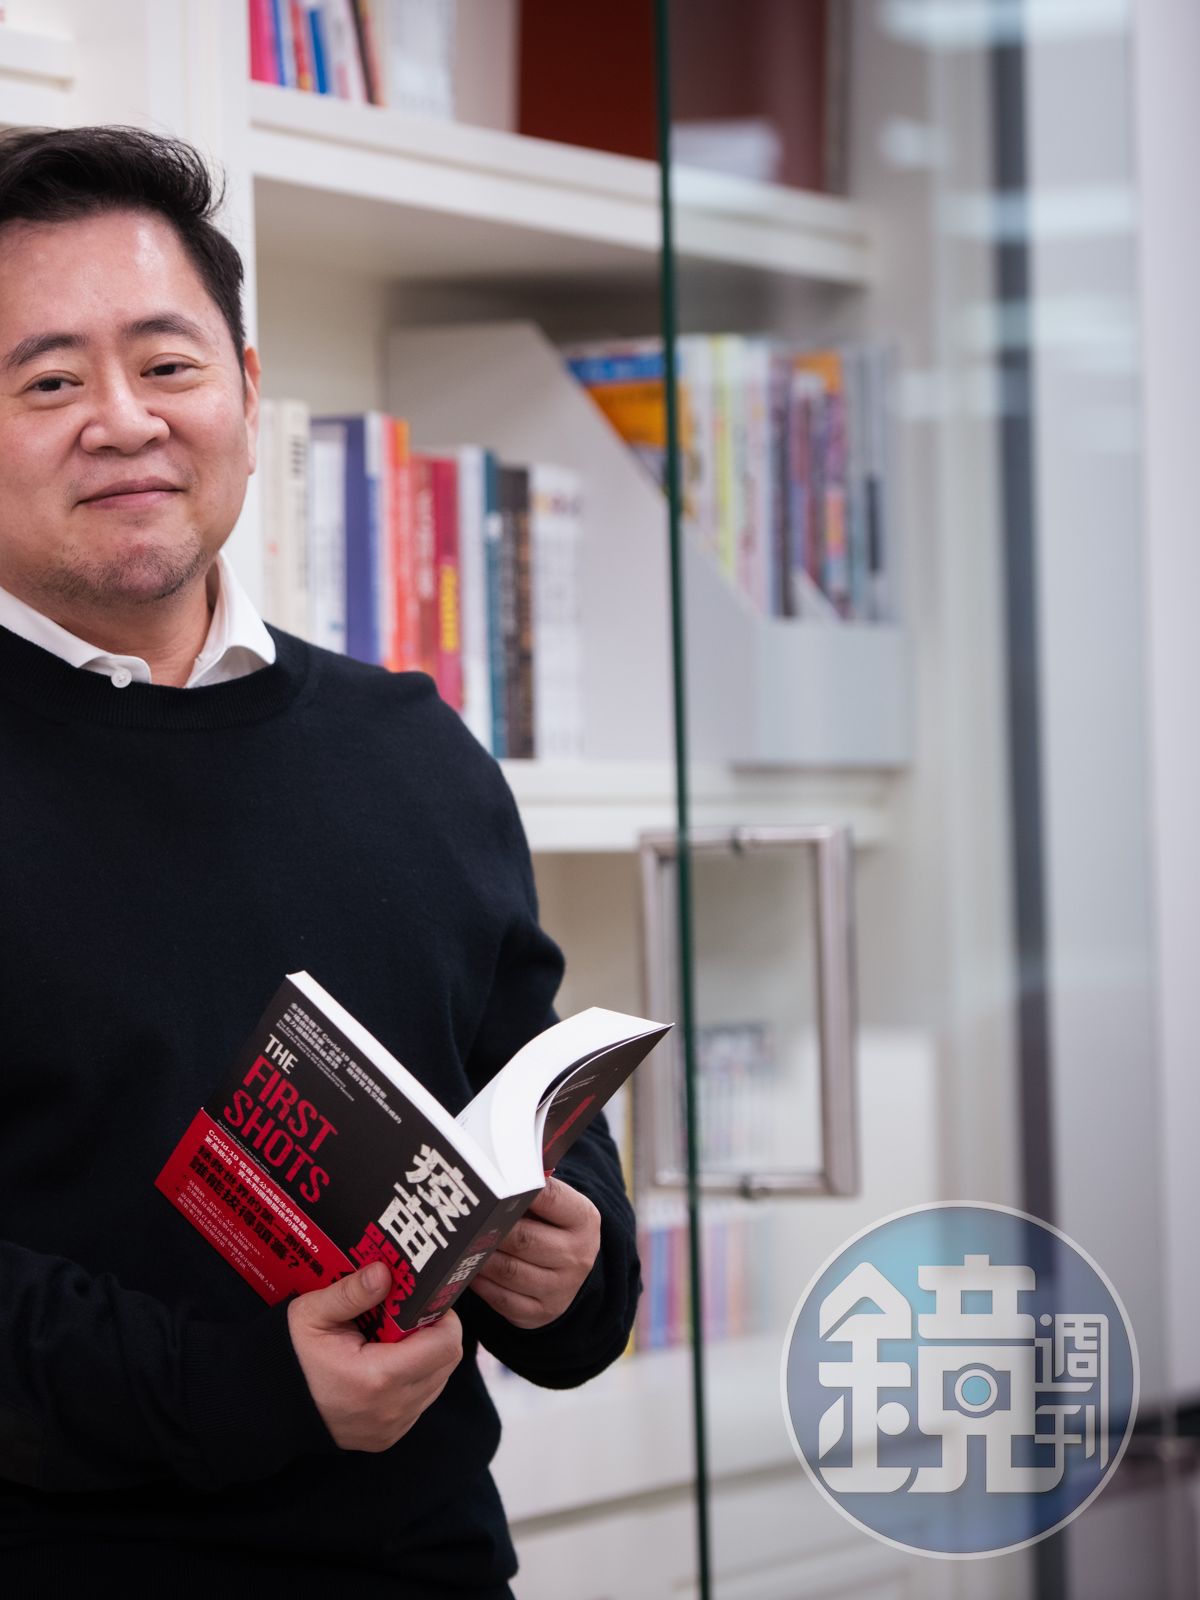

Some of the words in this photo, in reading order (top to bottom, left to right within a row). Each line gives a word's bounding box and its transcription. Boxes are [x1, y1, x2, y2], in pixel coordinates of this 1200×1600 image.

[263, 1032, 299, 1075] THE
[240, 1055, 339, 1148] FIRST
[207, 1128, 239, 1161] Covid-19
[221, 1088, 332, 1204] SHOTS
